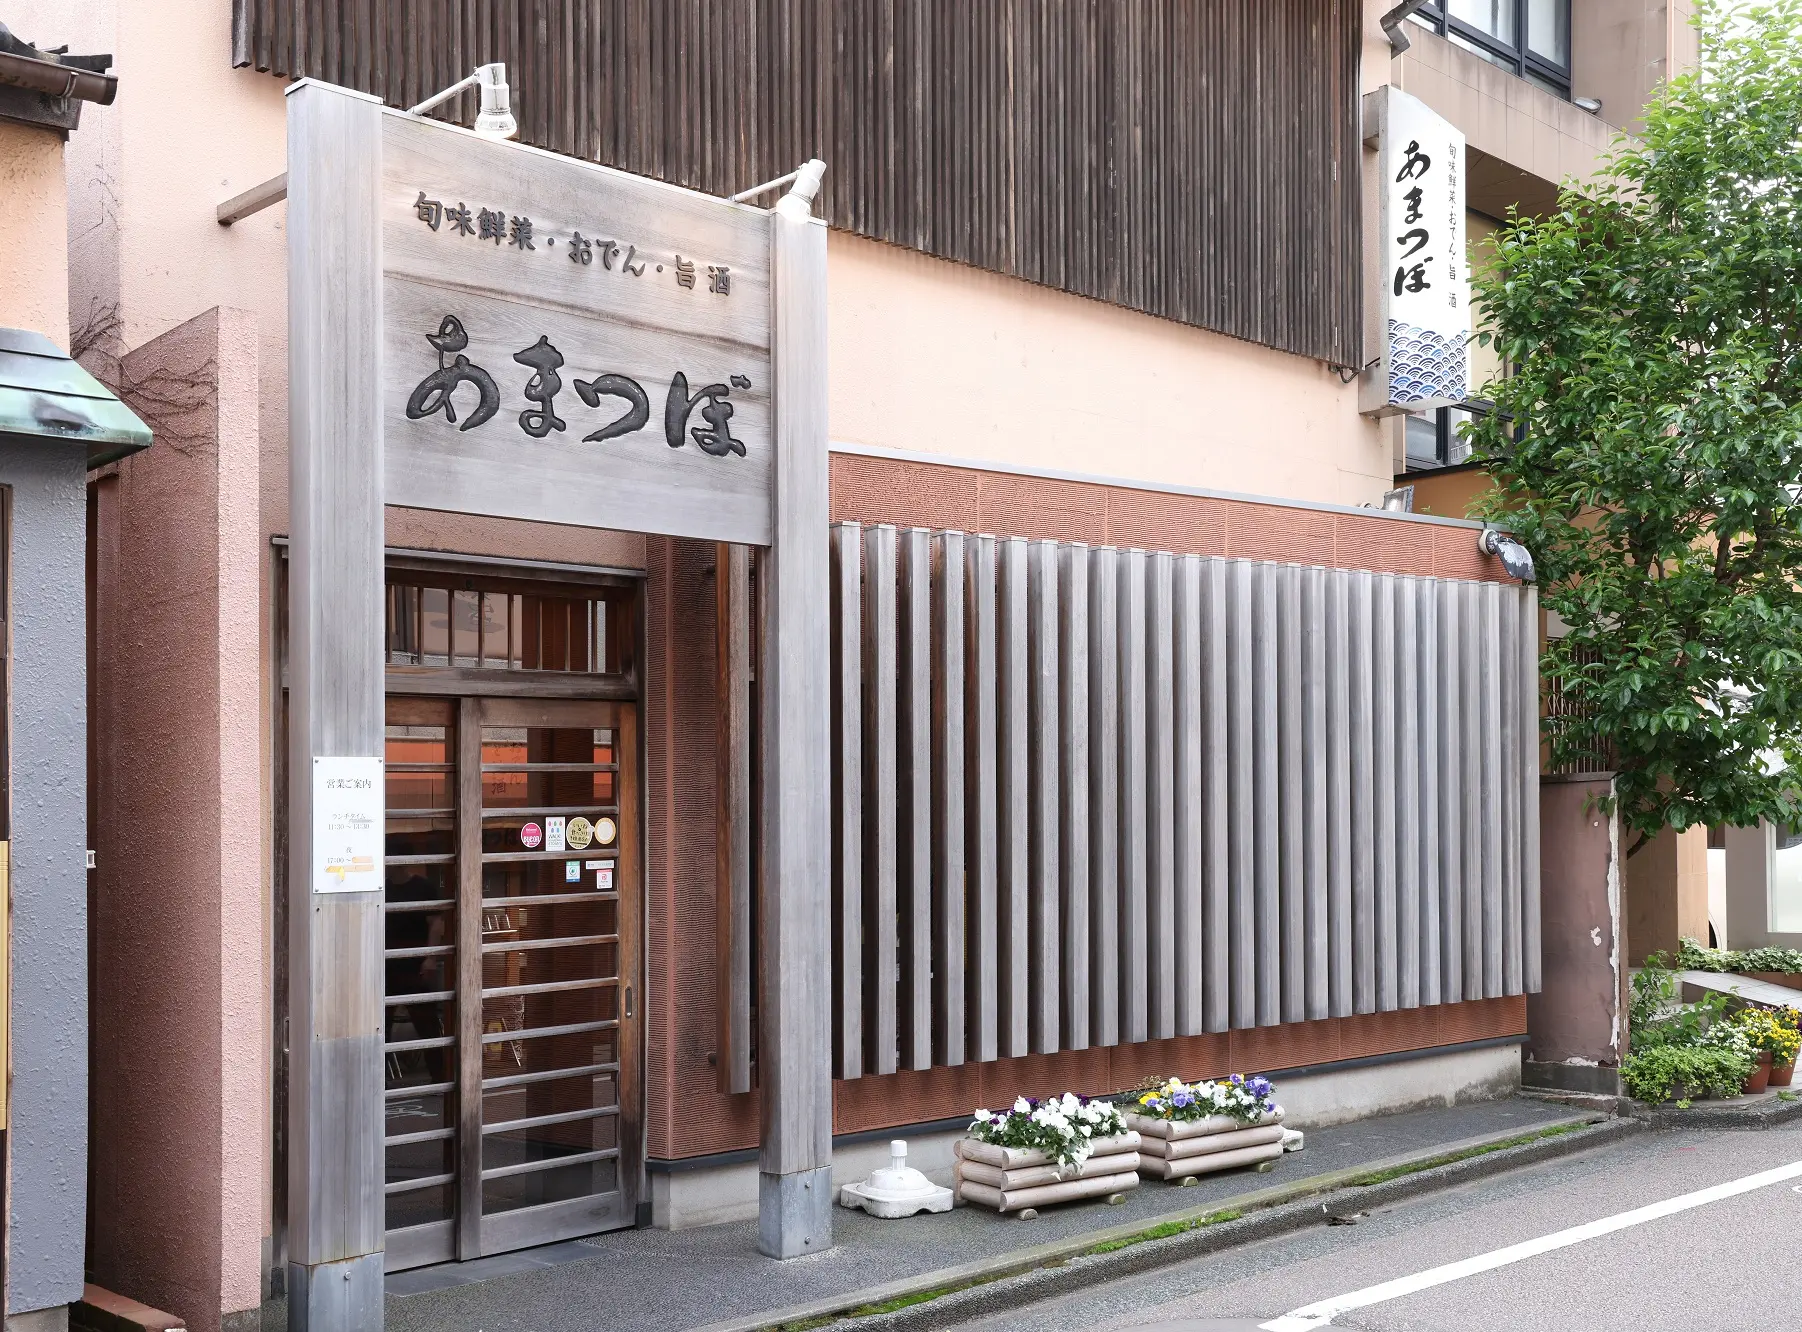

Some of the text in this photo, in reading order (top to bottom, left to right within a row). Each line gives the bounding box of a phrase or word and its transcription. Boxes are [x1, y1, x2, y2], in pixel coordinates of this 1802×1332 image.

[1393, 139, 1434, 297] あまつぼ
[406, 314, 751, 457] あまつぼ
[326, 778, 372, 789] 営業ご案内
